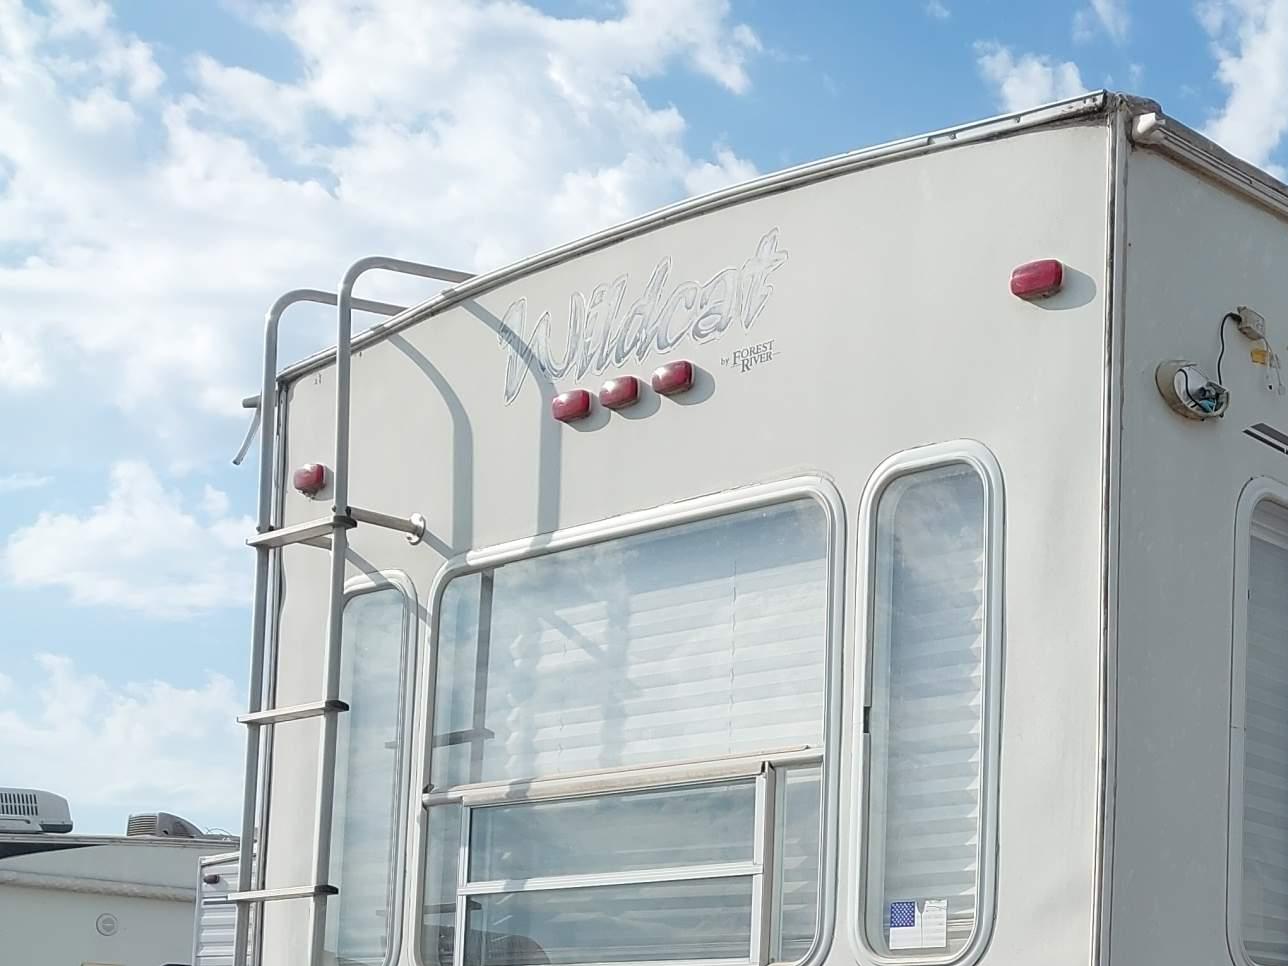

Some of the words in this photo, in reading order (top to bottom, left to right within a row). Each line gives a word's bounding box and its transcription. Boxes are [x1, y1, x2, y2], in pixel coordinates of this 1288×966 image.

[498, 226, 788, 406] Wildcat
[720, 358, 730, 367] by
[732, 339, 775, 365] FOREST
[741, 351, 773, 373] RIVER
